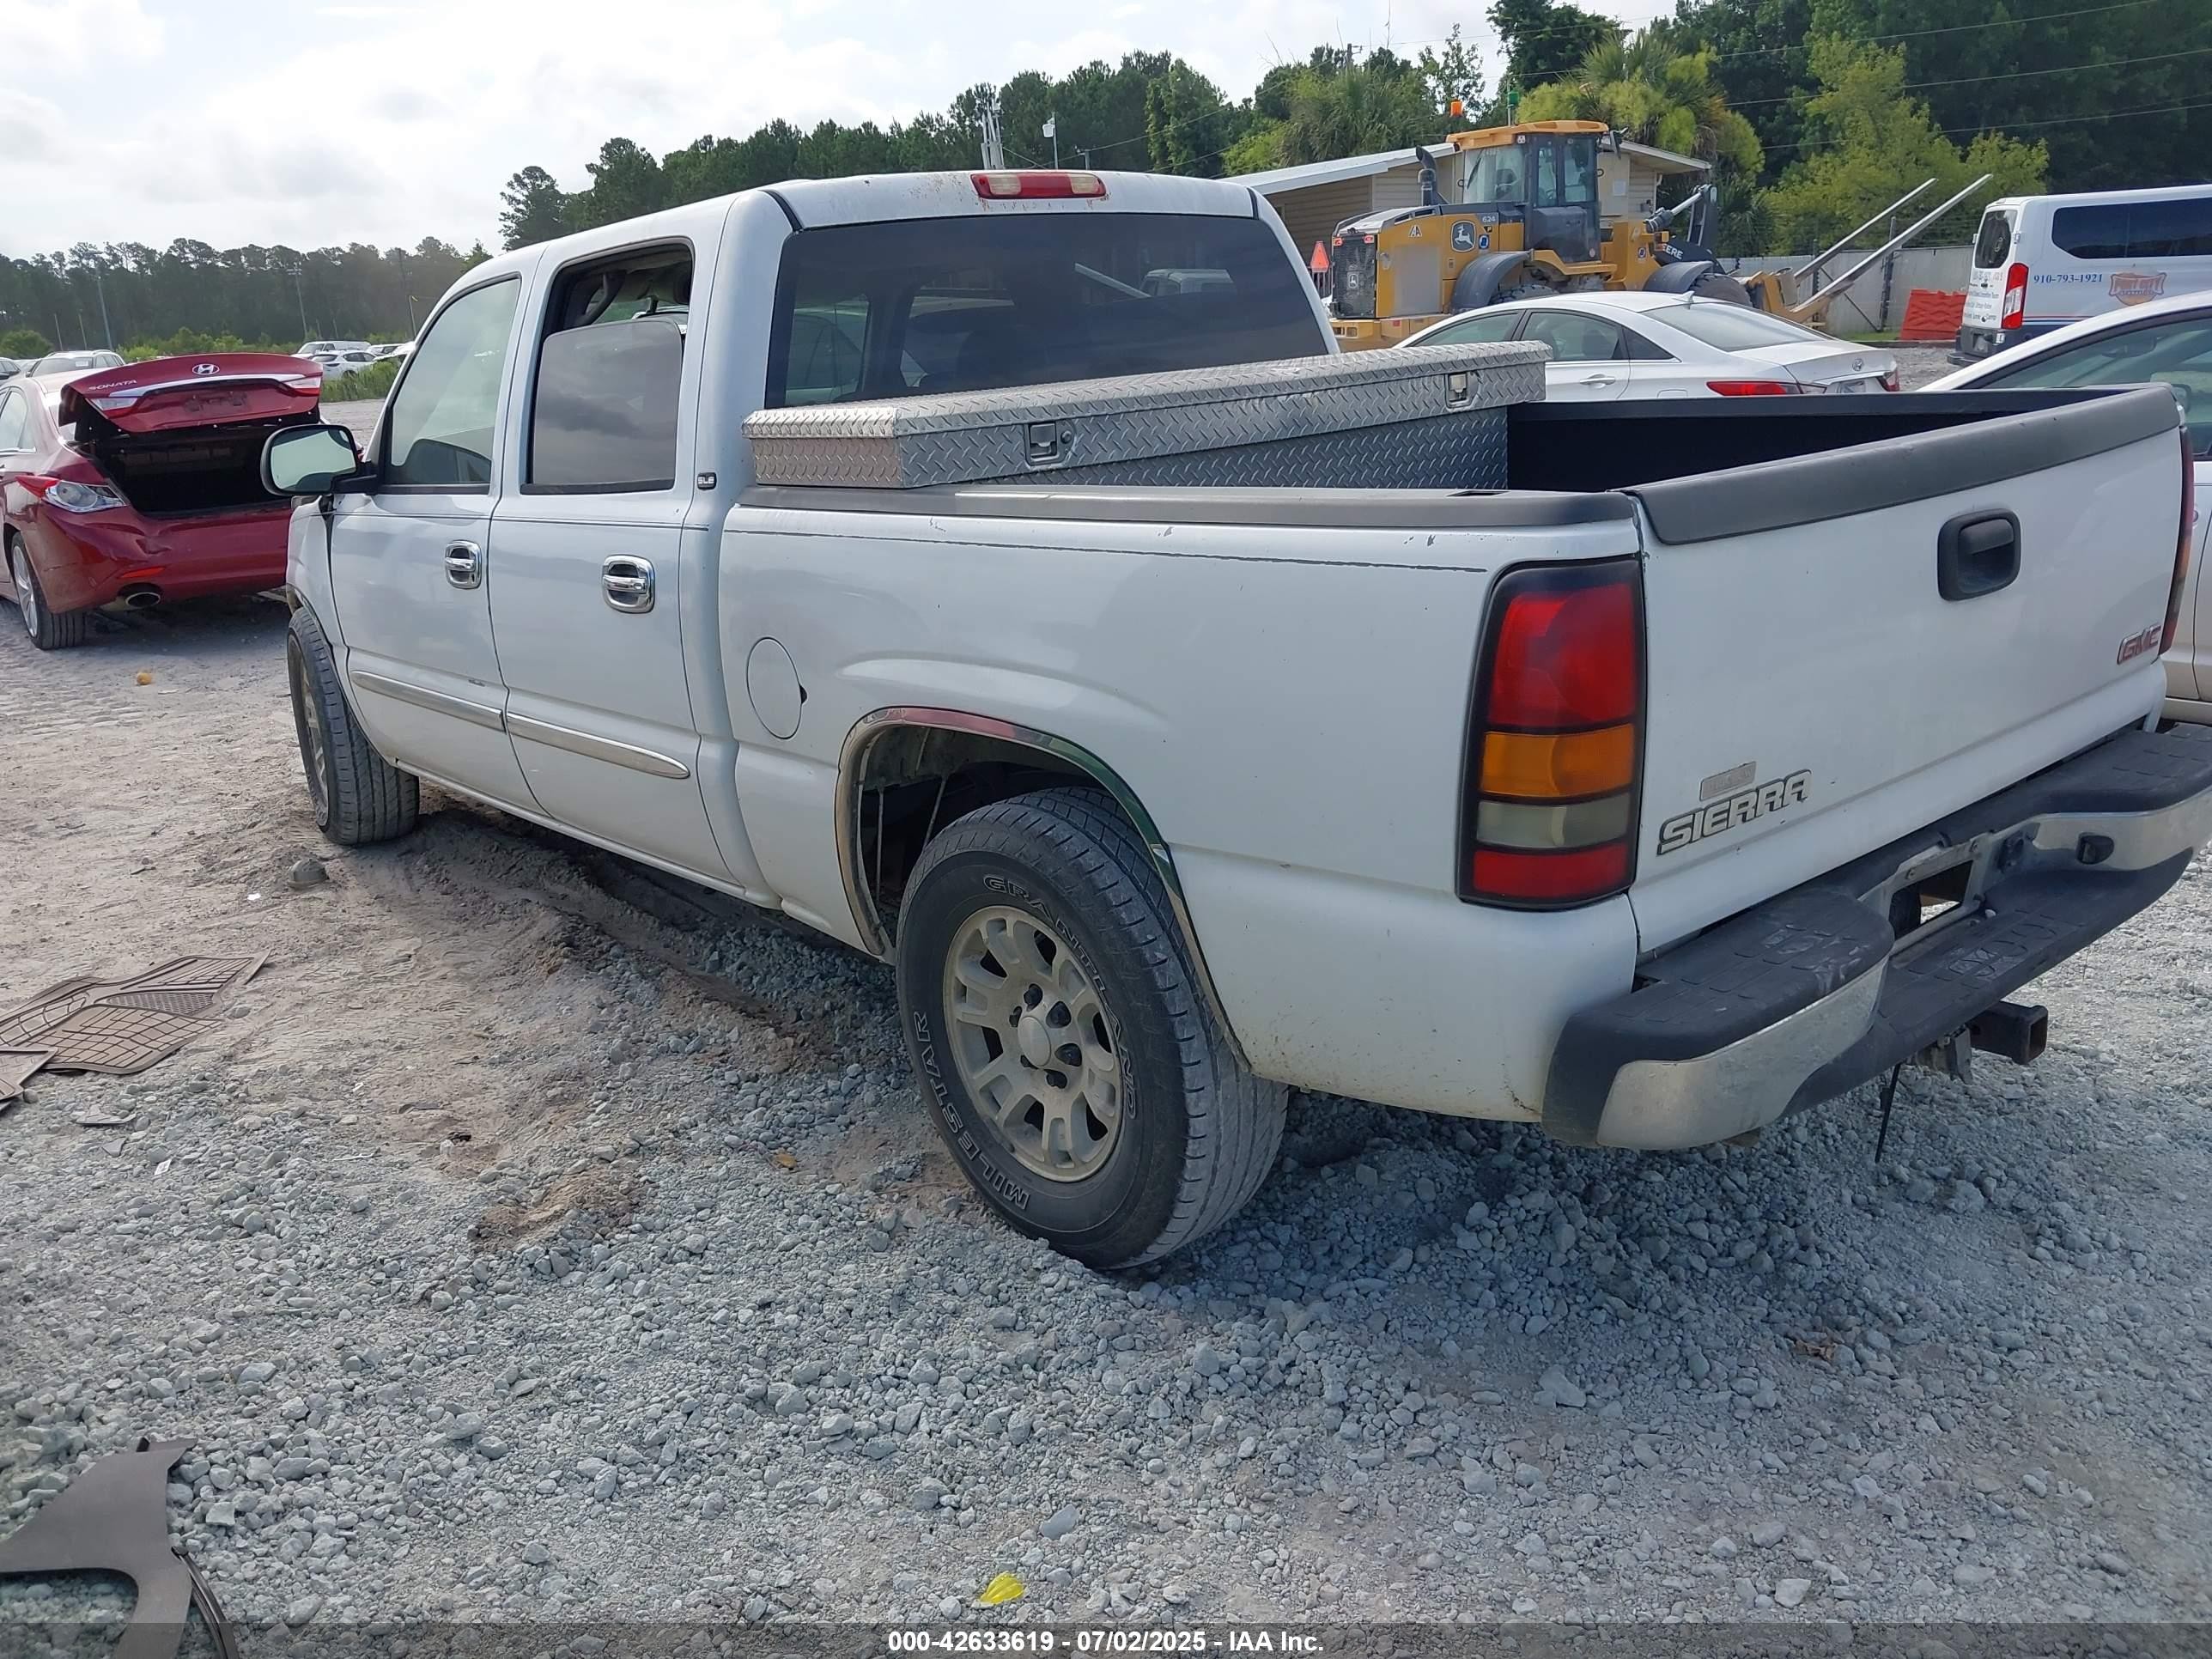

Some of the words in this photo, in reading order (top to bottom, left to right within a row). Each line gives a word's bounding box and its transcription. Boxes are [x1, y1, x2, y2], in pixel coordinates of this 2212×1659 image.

[2033, 273, 2103, 284] 910-793-1921
[88, 380, 137, 391] SONATA
[697, 476, 714, 484] SLE
[2117, 624, 2161, 665] GMC
[1656, 769, 1812, 856] SIERRA
[913, 1011, 1030, 1211] MILESTAR
